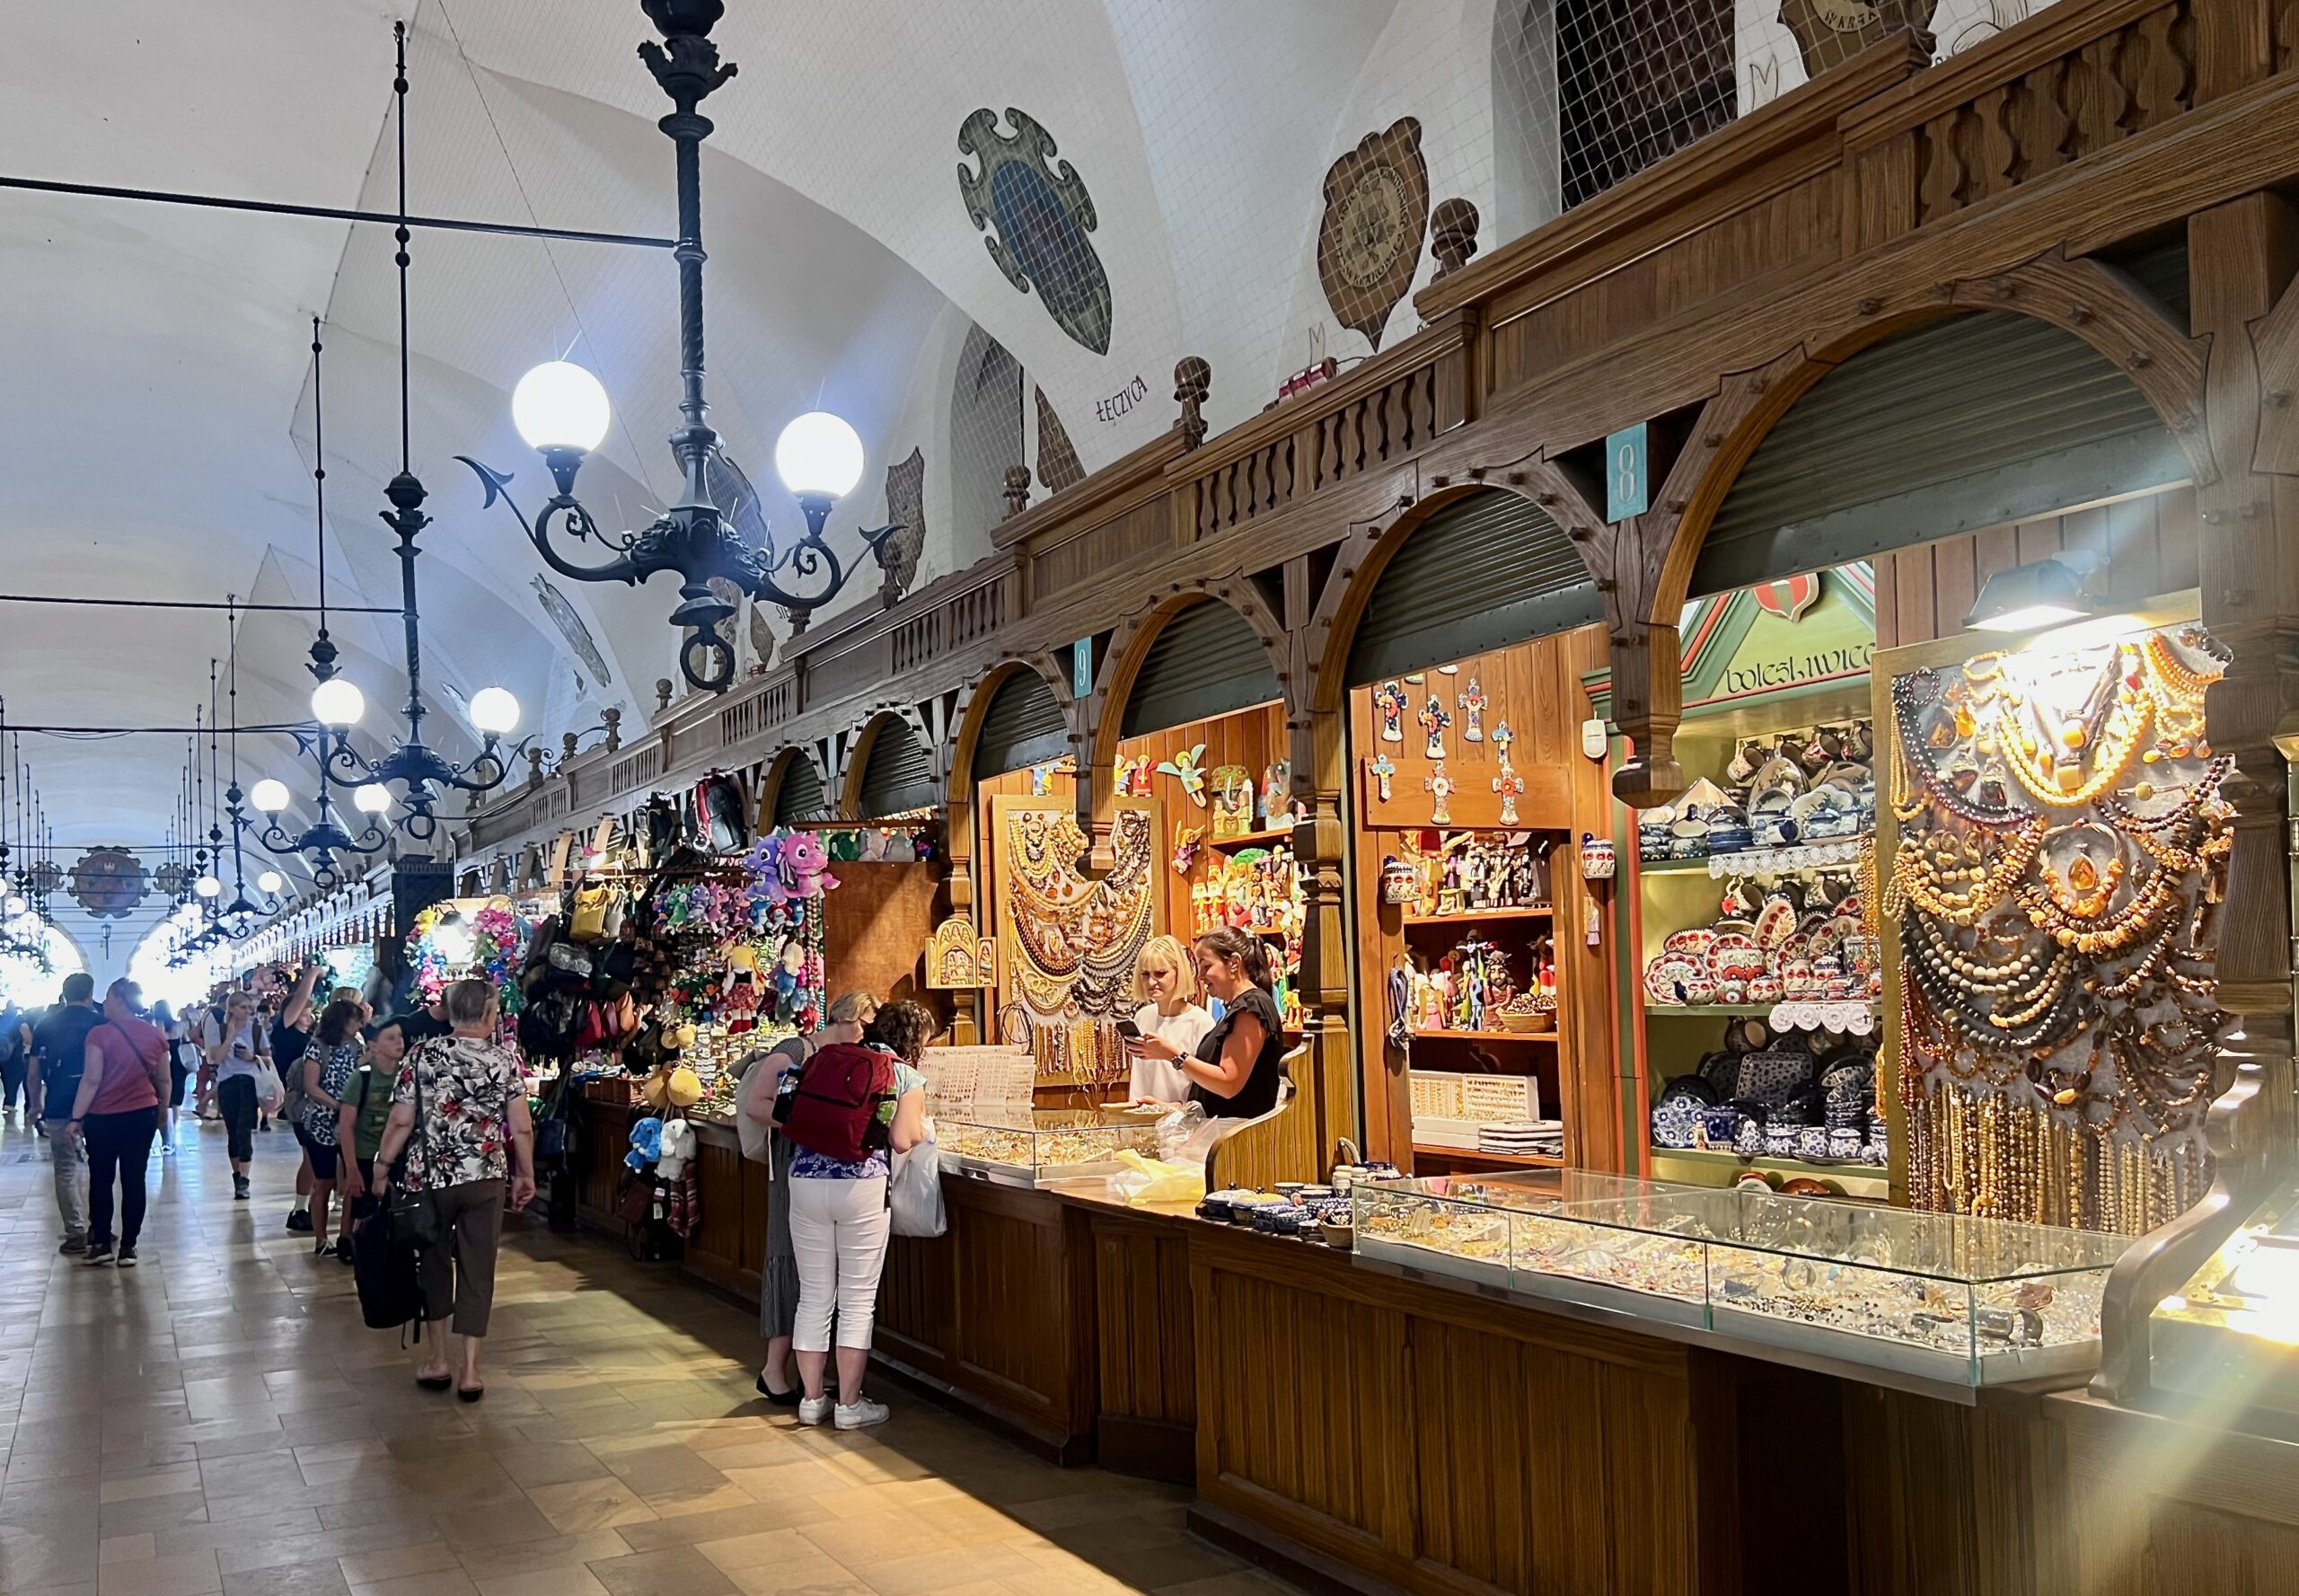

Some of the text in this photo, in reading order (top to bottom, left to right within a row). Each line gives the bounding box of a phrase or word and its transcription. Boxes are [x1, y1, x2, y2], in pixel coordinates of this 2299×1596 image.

[1096, 374, 1149, 427] ŁĘCZYCA
[1618, 444, 1634, 503] 8
[1079, 648, 1087, 687] 9
